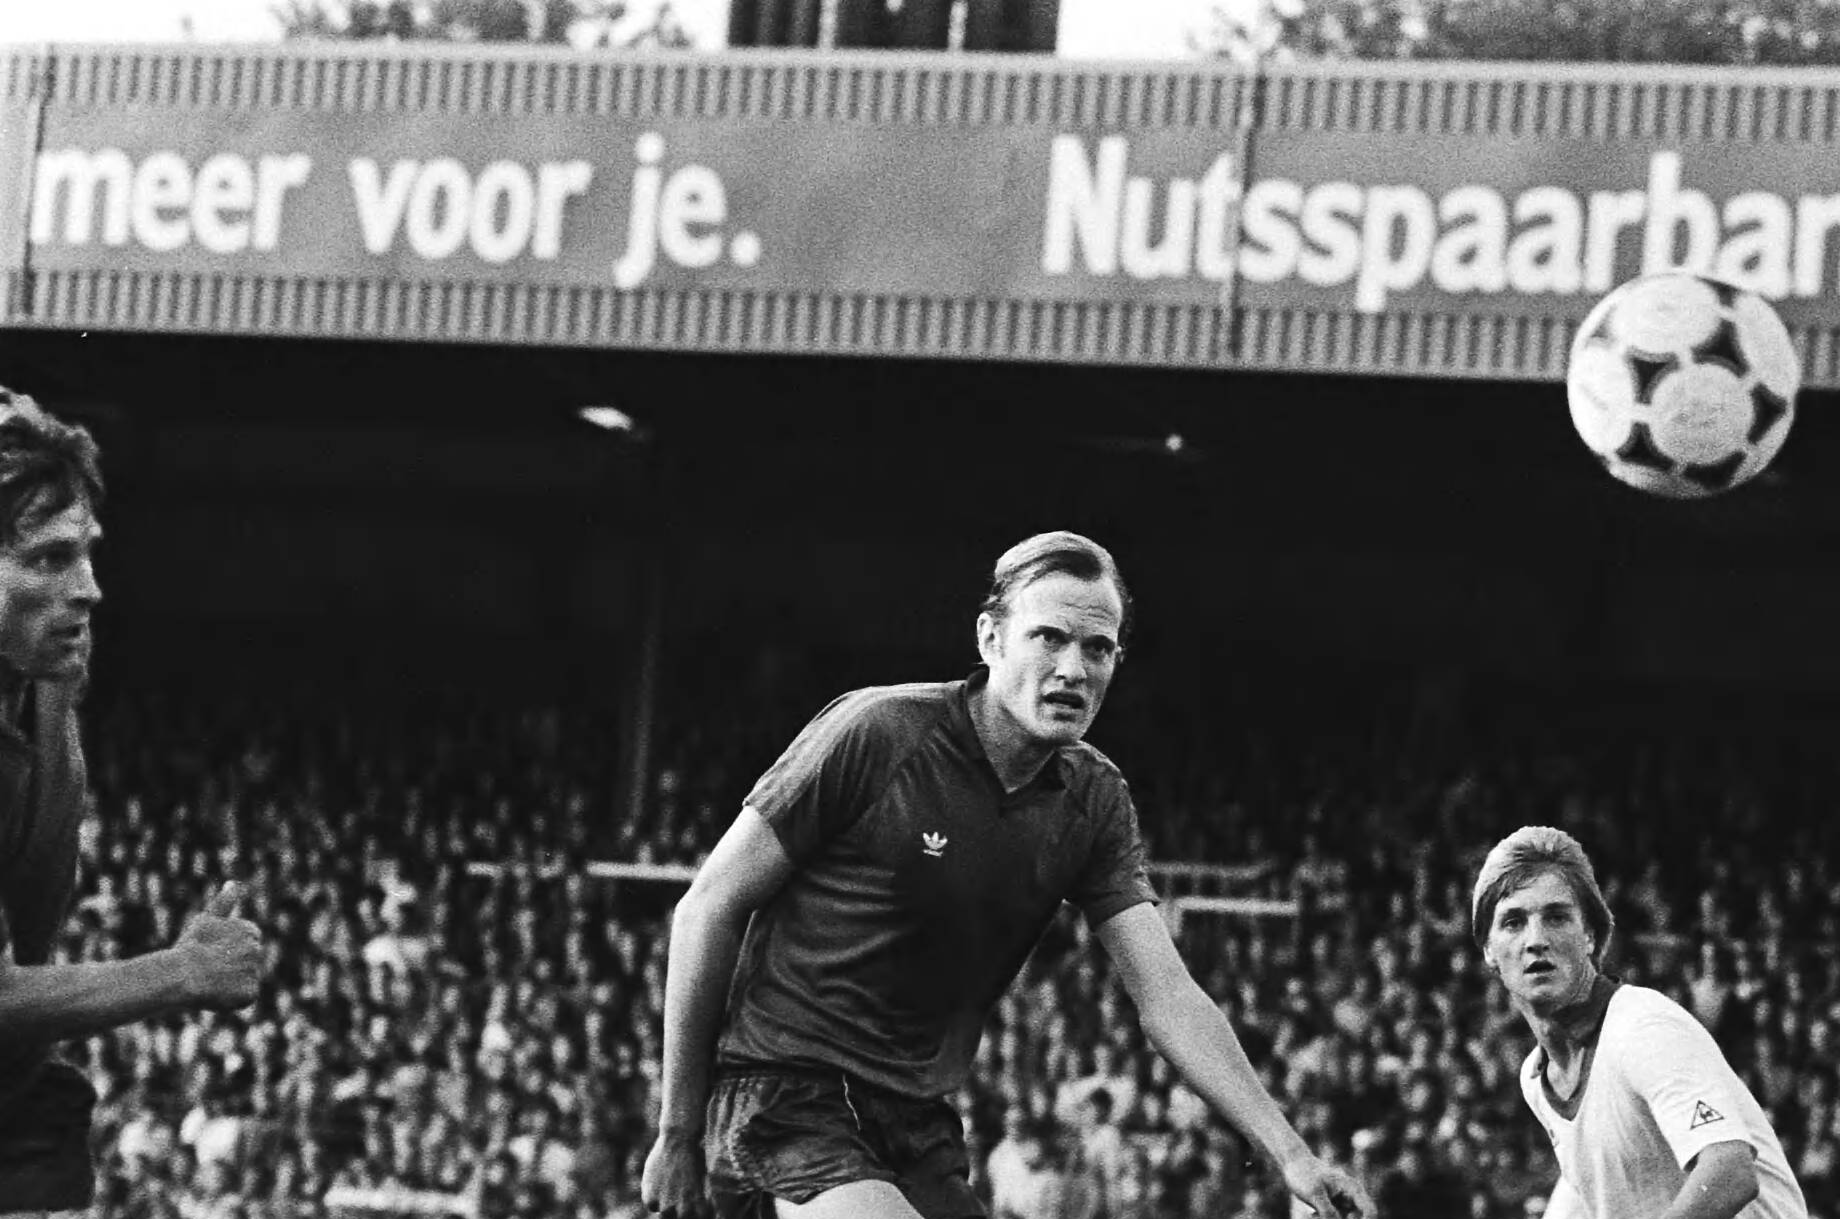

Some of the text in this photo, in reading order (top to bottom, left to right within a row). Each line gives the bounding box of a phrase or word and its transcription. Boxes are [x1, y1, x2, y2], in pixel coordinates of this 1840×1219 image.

[29, 143, 313, 255] meer
[347, 157, 593, 263] voor
[612, 131, 761, 289] je.
